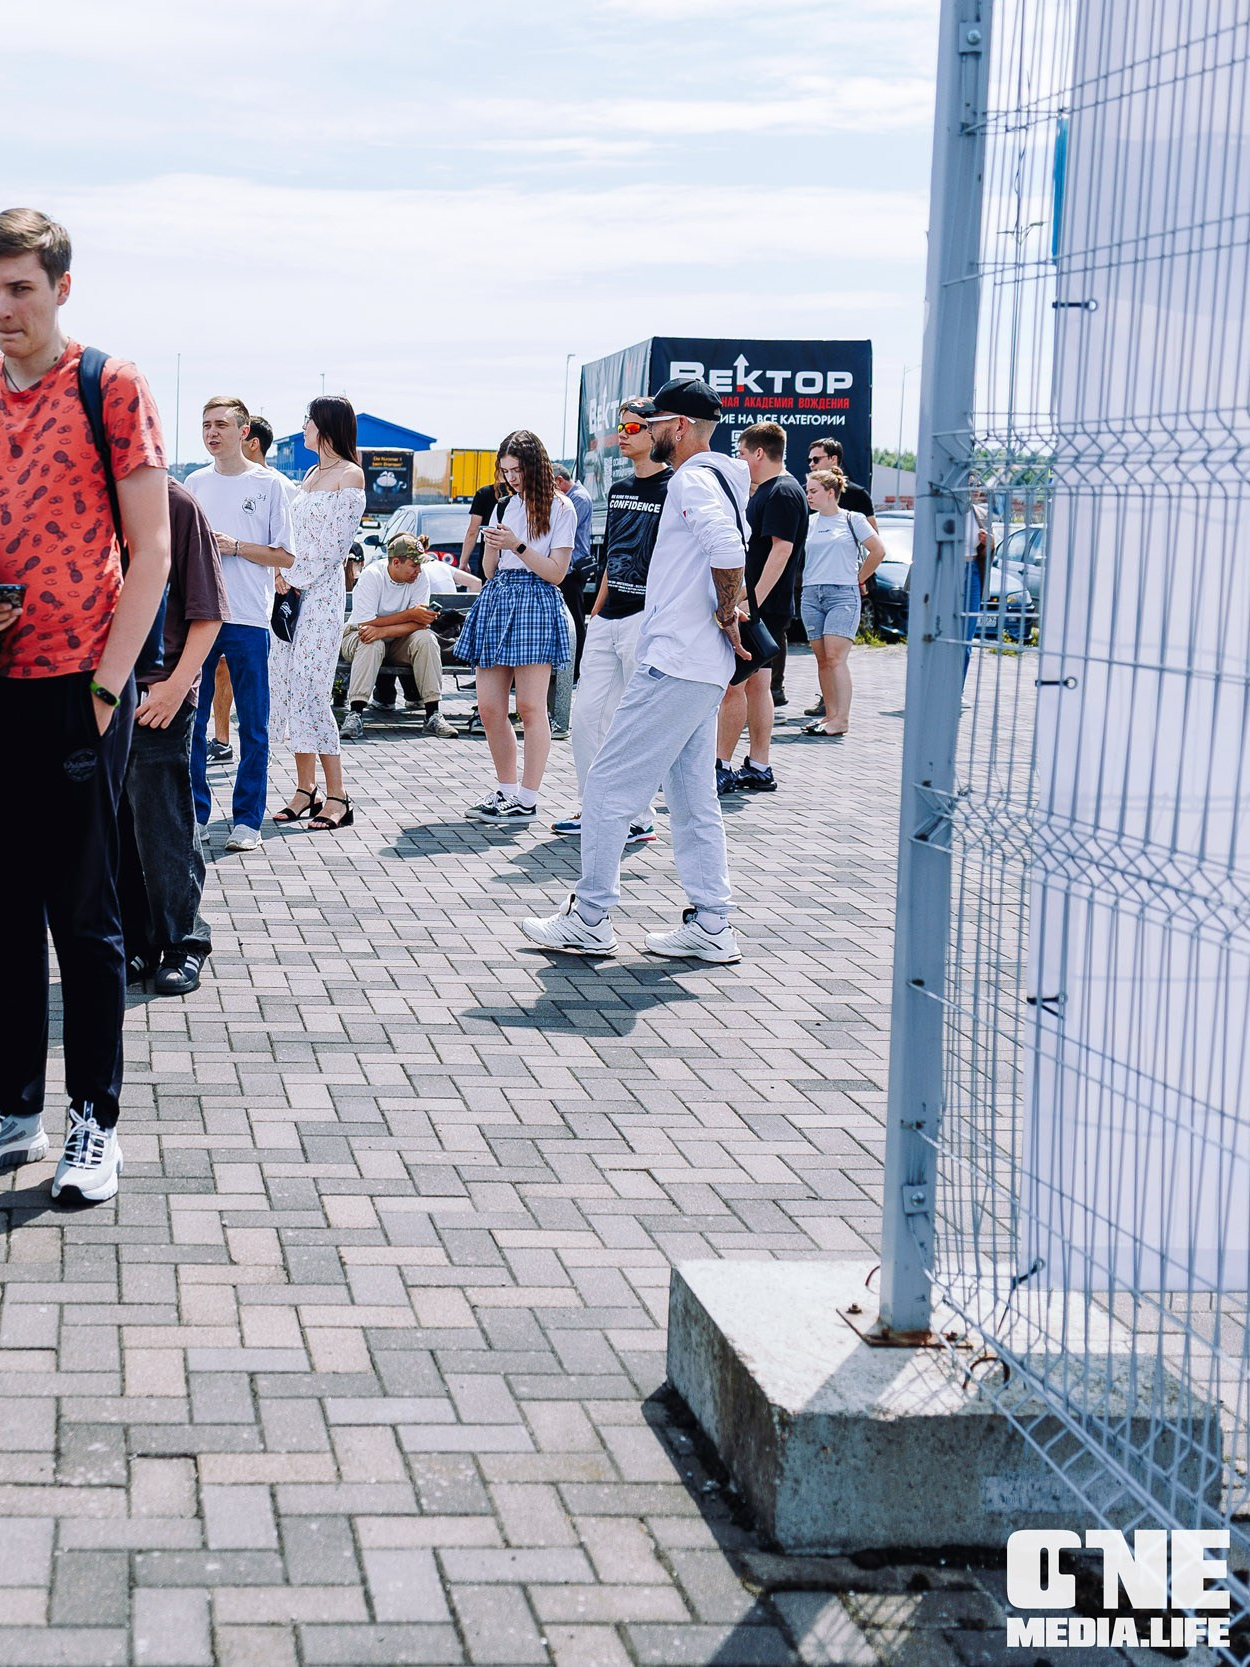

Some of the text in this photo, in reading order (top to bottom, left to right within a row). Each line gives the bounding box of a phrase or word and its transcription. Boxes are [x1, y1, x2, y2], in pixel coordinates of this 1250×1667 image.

[670, 354, 853, 394] ВЕКТОР
[721, 396, 849, 410] НАЯ АКАДЕМИЯ ВОЖДЕНИЯ
[738, 414, 754, 424] НА
[757, 414, 778, 424] ВСЕ
[780, 415, 846, 425] КАТЕГОРИИ
[609, 499, 661, 513] CONFIDENCE
